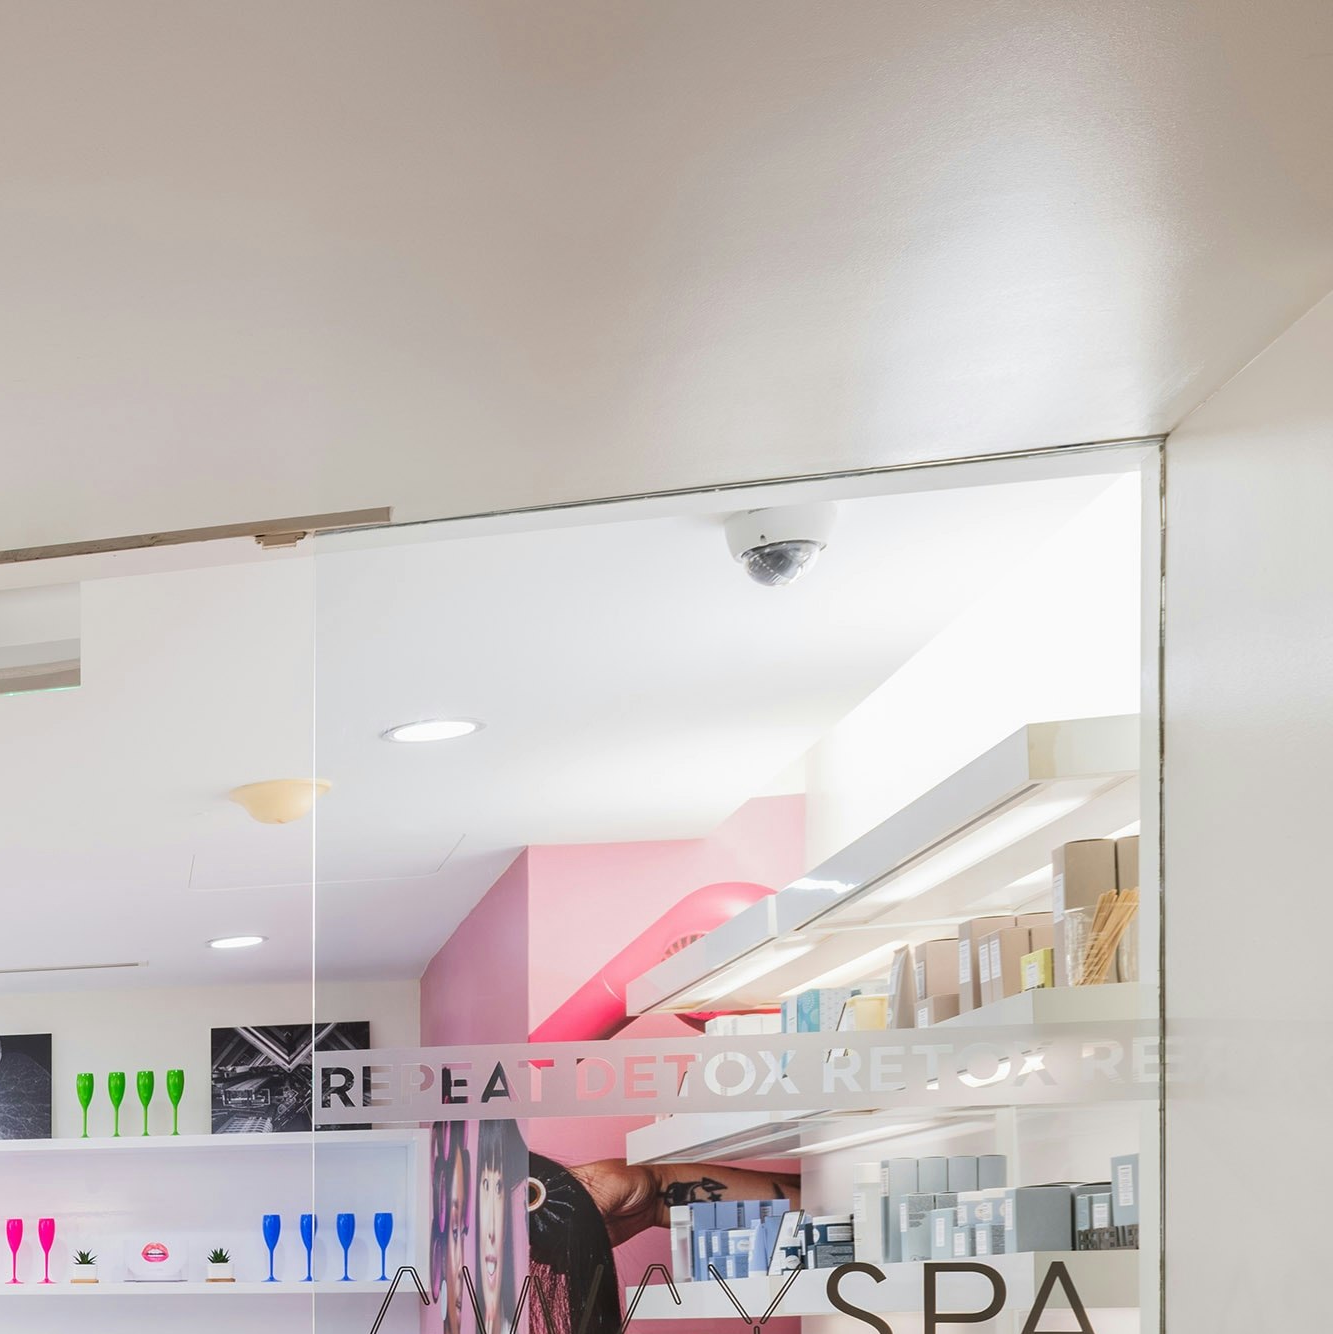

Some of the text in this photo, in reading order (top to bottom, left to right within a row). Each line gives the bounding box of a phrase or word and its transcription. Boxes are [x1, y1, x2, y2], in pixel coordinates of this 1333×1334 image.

[320, 1058, 555, 1109] REPEAT
[576, 1049, 801, 1100] DETOX
[823, 1041, 1058, 1093] RETOX
